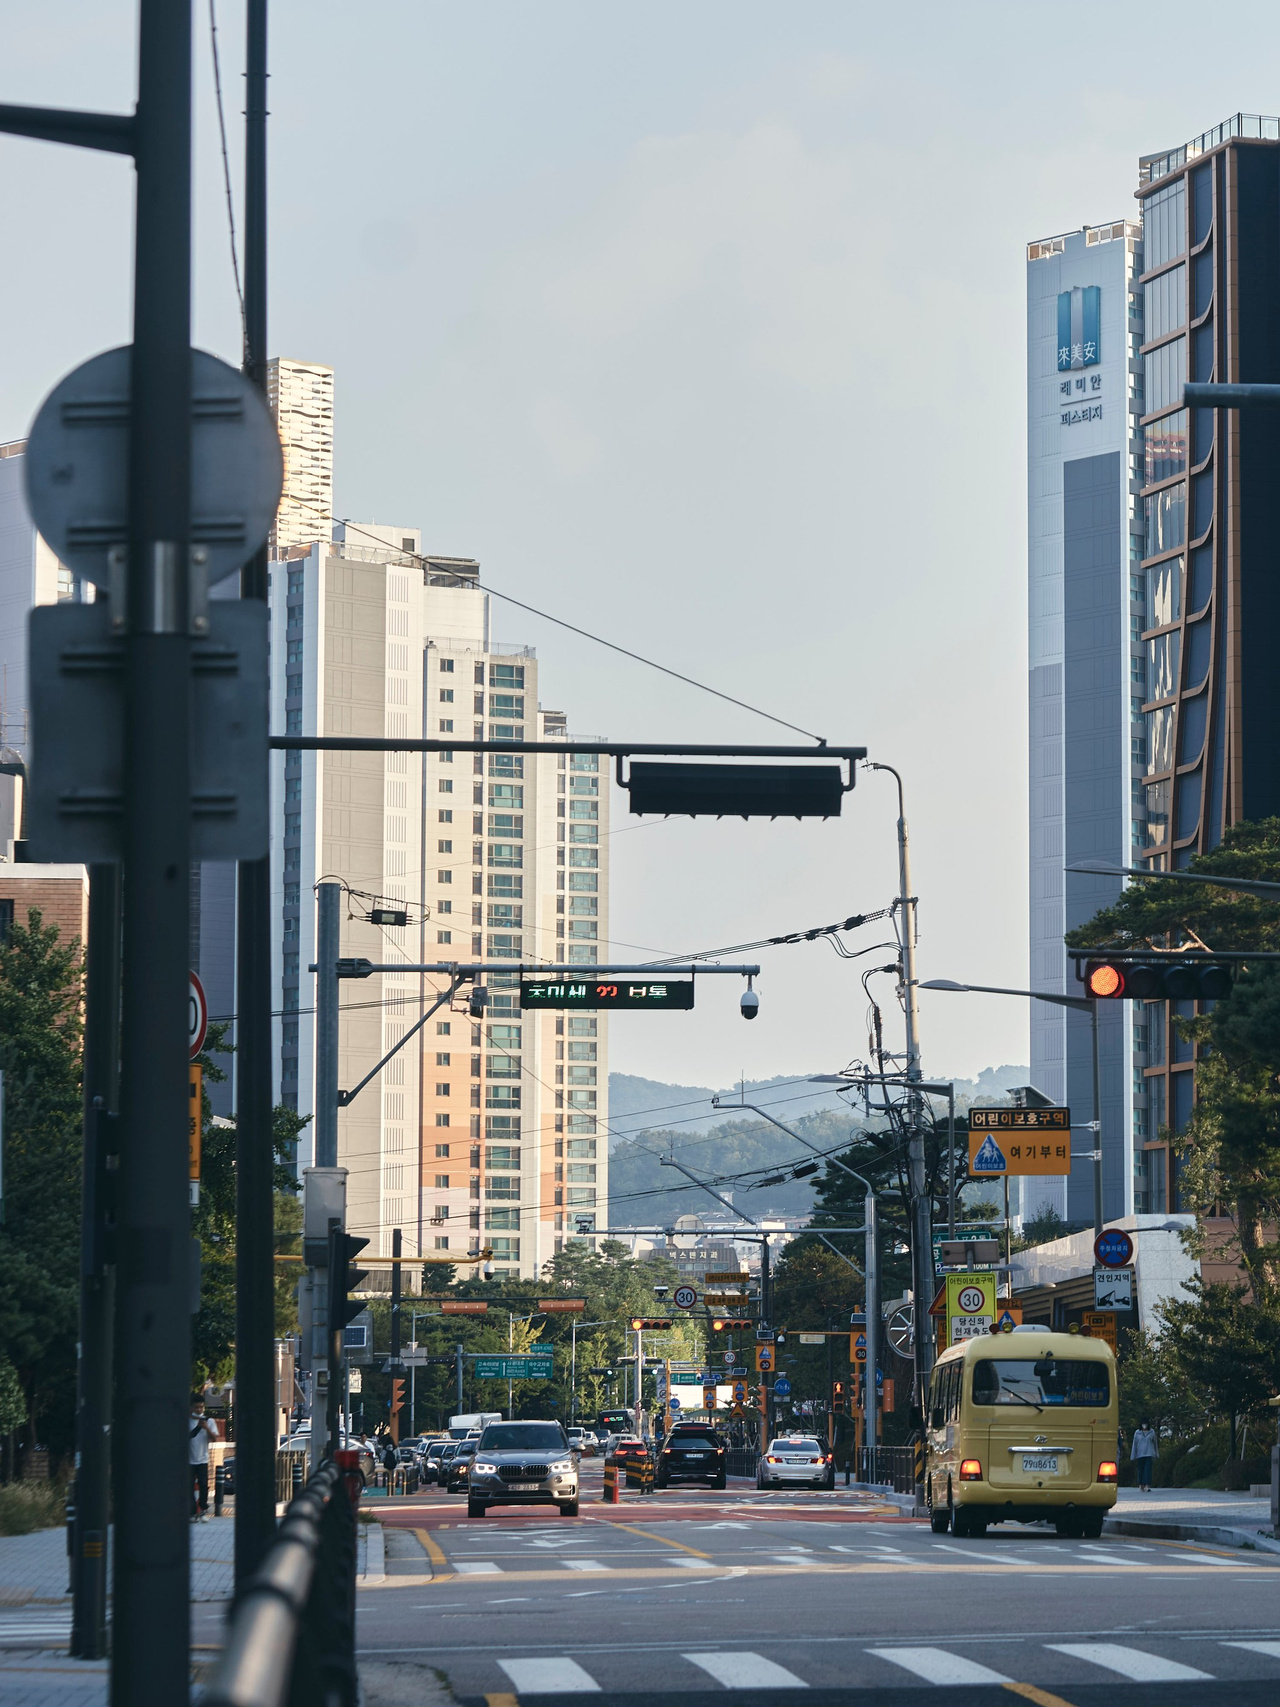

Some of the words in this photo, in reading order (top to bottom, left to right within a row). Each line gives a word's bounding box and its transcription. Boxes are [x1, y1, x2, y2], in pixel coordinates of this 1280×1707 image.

[1058, 341, 1096, 366] 來美安
[1060, 374, 1102, 396] 래미안
[974, 1112, 1064, 1126] 어린이보호구역
[949, 1276, 993, 1285] 어린이보호구역
[1097, 1273, 1130, 1283] 견인지역
[678, 1291, 693, 1303] 30
[963, 1293, 980, 1307] 30
[959, 1316, 985, 1326] 당신의
[954, 1327, 989, 1335] 현재속도
[857, 1350, 866, 1358] 30
